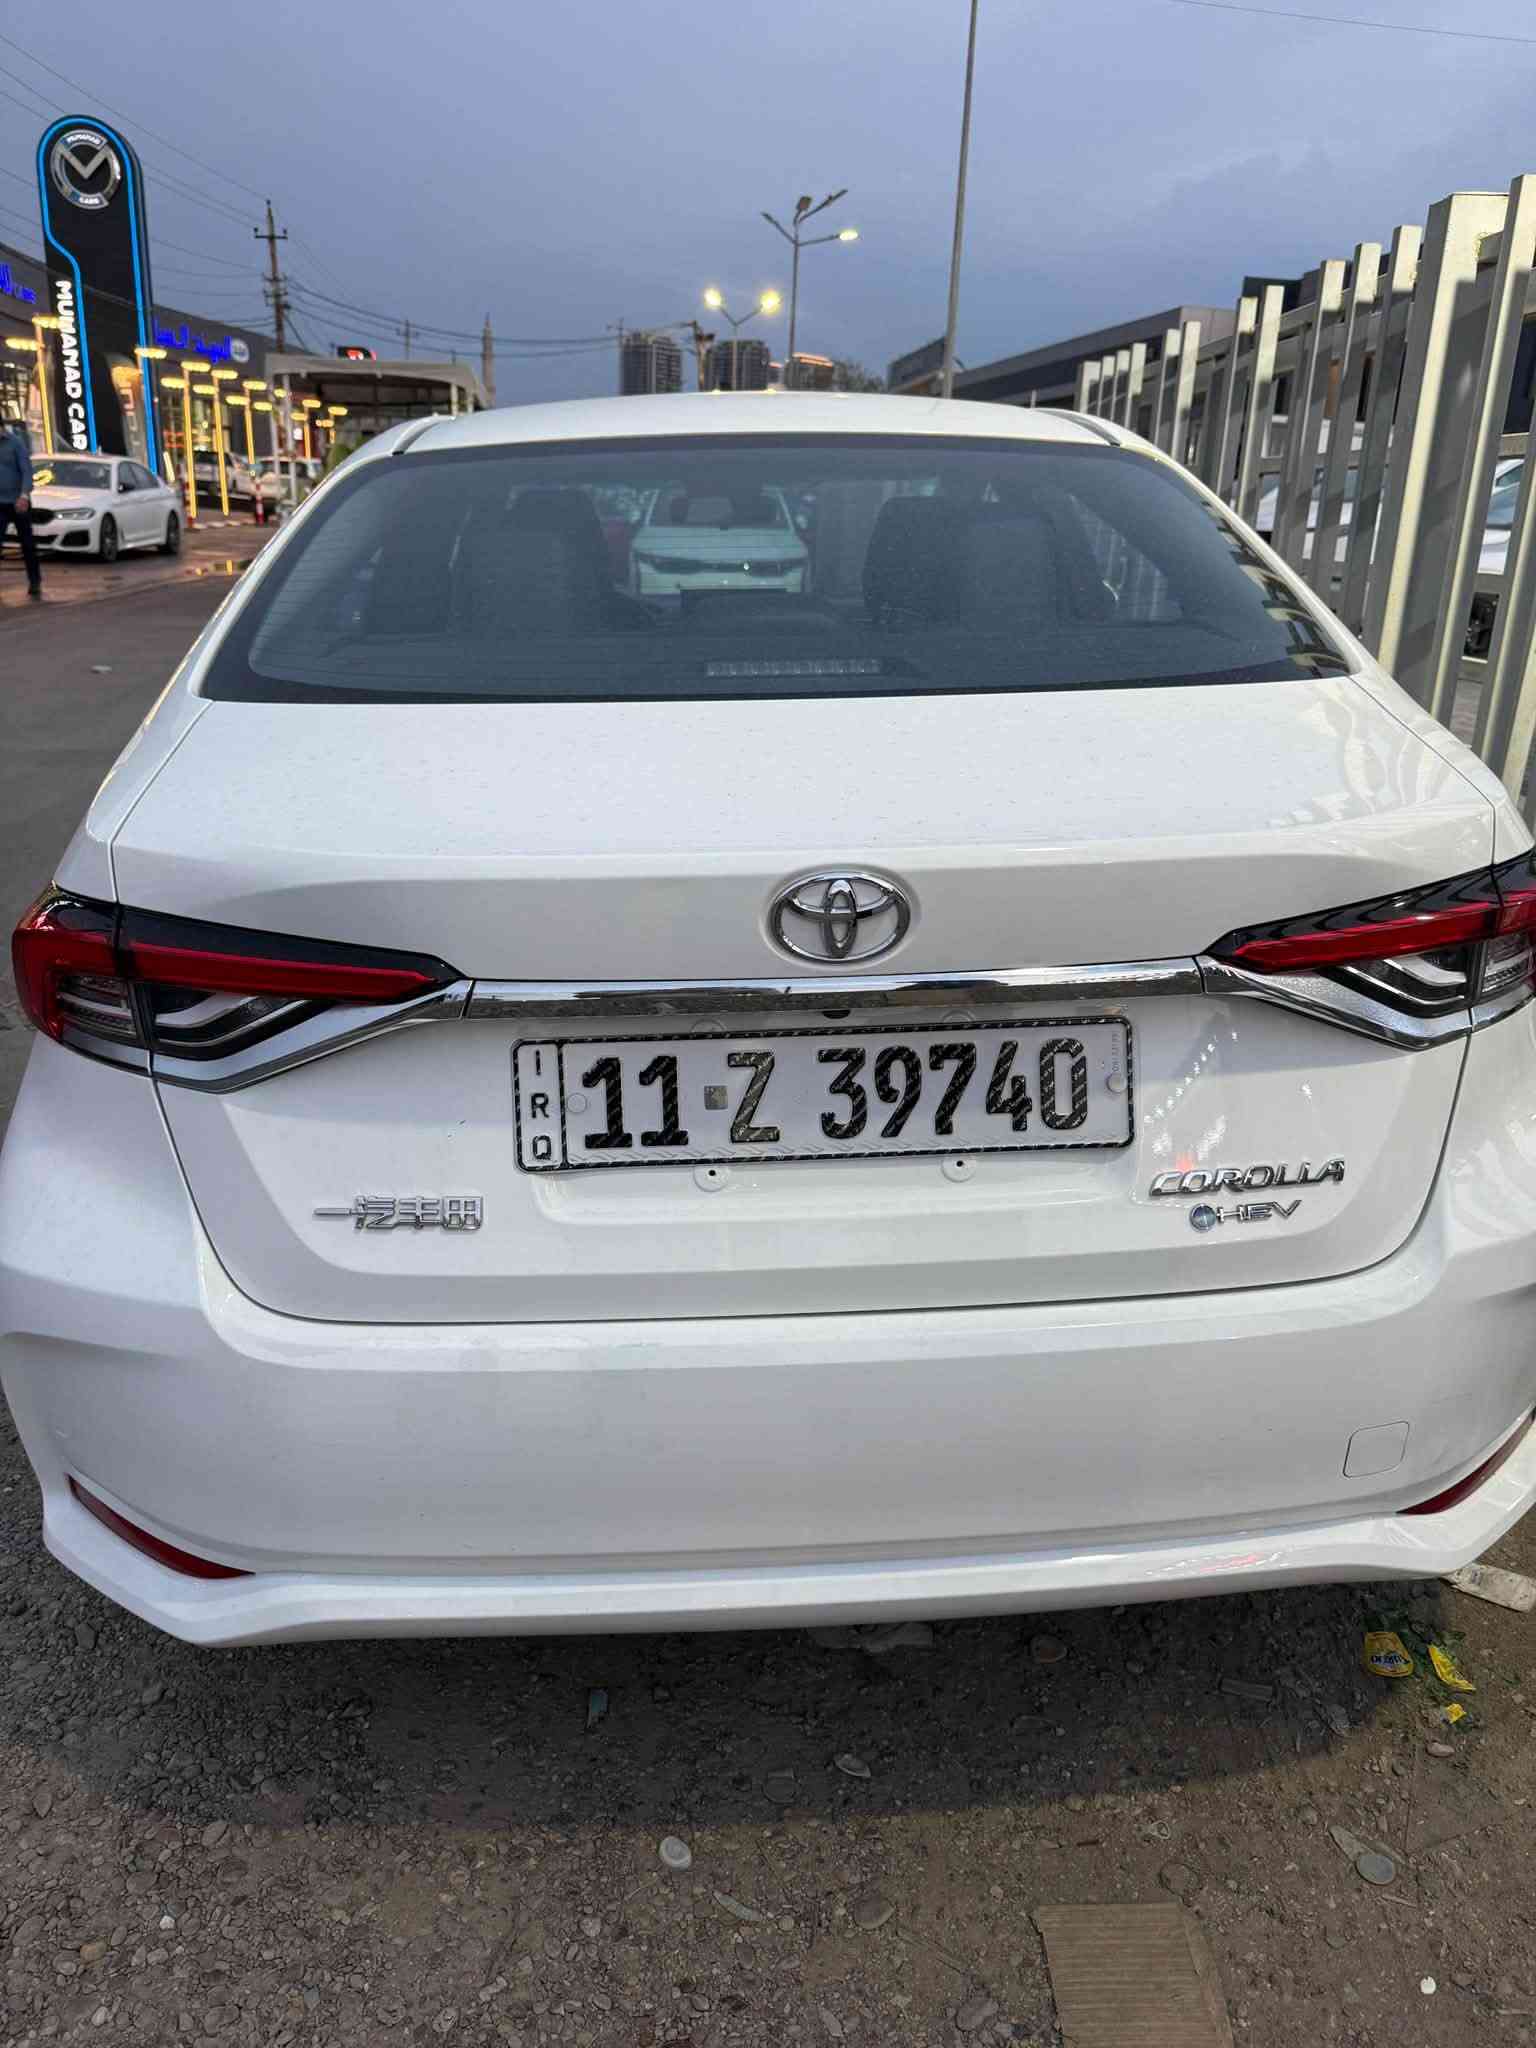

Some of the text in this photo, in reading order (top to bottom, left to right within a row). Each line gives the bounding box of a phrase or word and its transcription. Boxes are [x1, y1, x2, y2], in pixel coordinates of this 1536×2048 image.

[67, 402, 88, 450] CAR
[582, 1054, 688, 1149] 11
[727, 1051, 780, 1144] Z
[817, 1037, 1089, 1140] 39740
[1151, 1160, 1345, 1197] COROLLA
[313, 1195, 483, 1231] 一汽丰田
[1216, 1199, 1303, 1223] HEV
